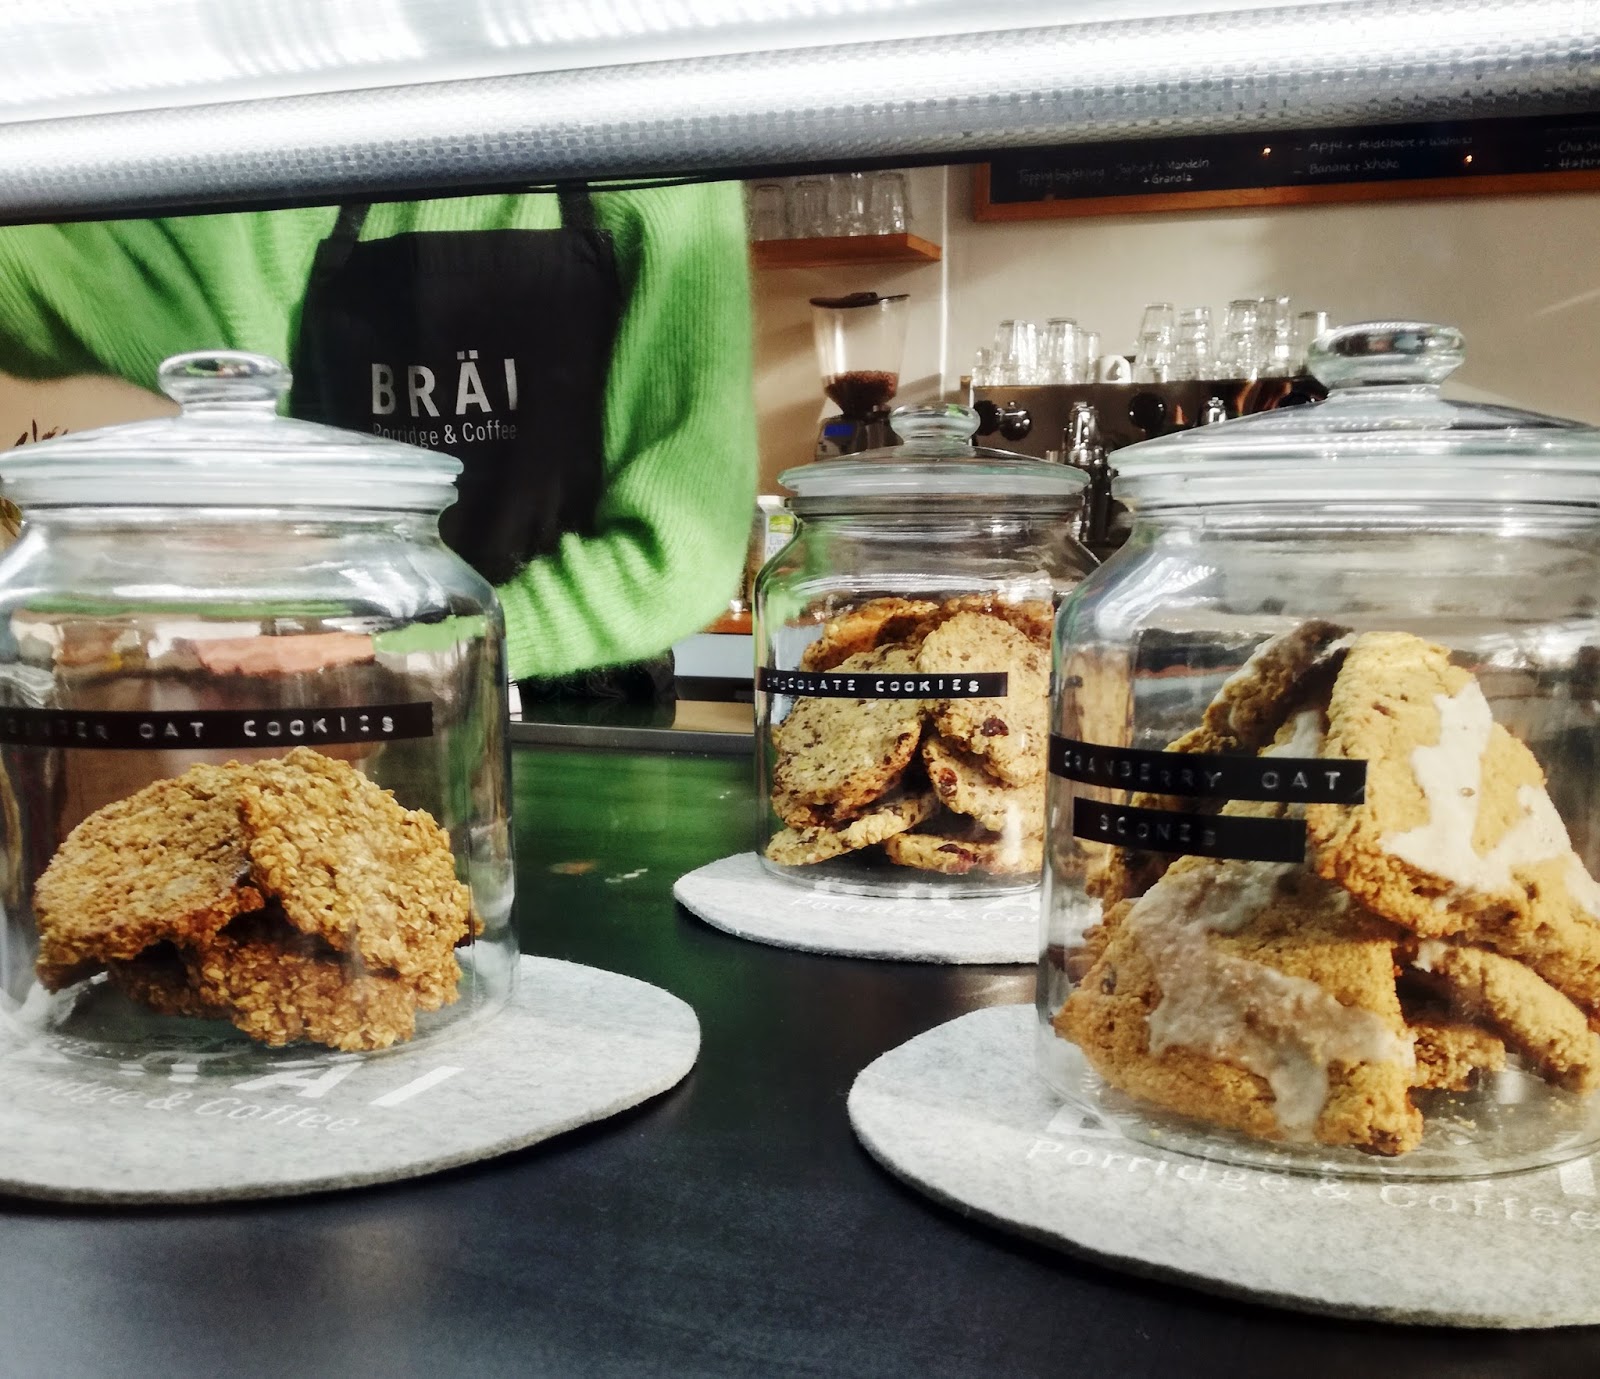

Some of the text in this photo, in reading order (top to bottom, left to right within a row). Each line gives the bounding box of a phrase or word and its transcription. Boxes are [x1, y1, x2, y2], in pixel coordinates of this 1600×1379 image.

[1151, 172, 1194, 184] Granola
[1309, 163, 1351, 175] Banane
[371, 350, 518, 417] BRÄI
[444, 424, 458, 445] &
[462, 420, 517, 443] Coffee
[875, 679, 980, 693] COOKIES
[138, 721, 204, 740] OAT
[243, 715, 394, 737] COOKIES
[1064, 750, 1341, 790] CRANBERRY OAT
[1100, 813, 1216, 846] SCONES
[144, 1091, 193, 1110] &
[194, 1097, 359, 1132] Coffee
[1026, 1139, 1290, 1192] Porridge
[1312, 1176, 1351, 1200] &
